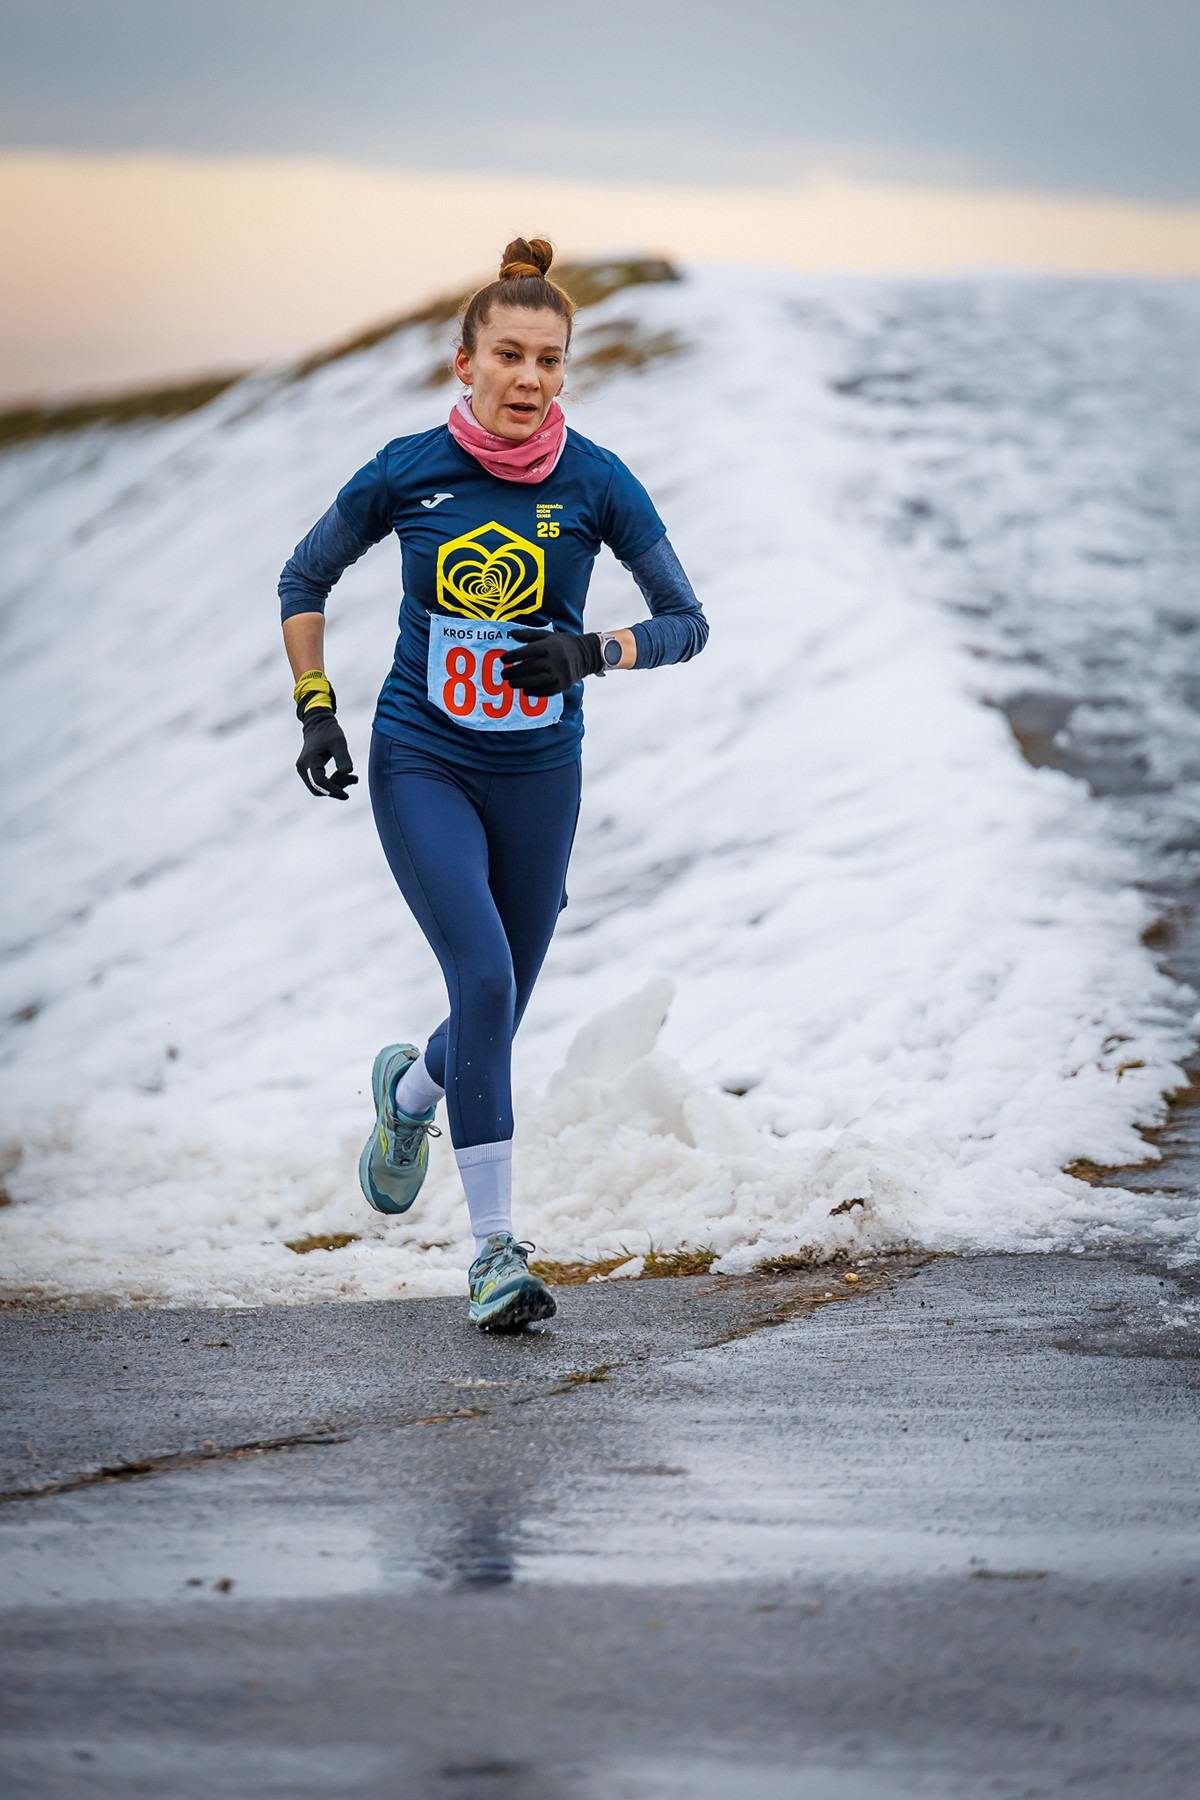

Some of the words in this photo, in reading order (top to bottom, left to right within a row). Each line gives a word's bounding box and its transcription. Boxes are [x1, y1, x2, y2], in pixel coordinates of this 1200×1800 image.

[536, 521, 560, 538] 25
[443, 627, 473, 639] KROS
[477, 630, 503, 640] LIGA
